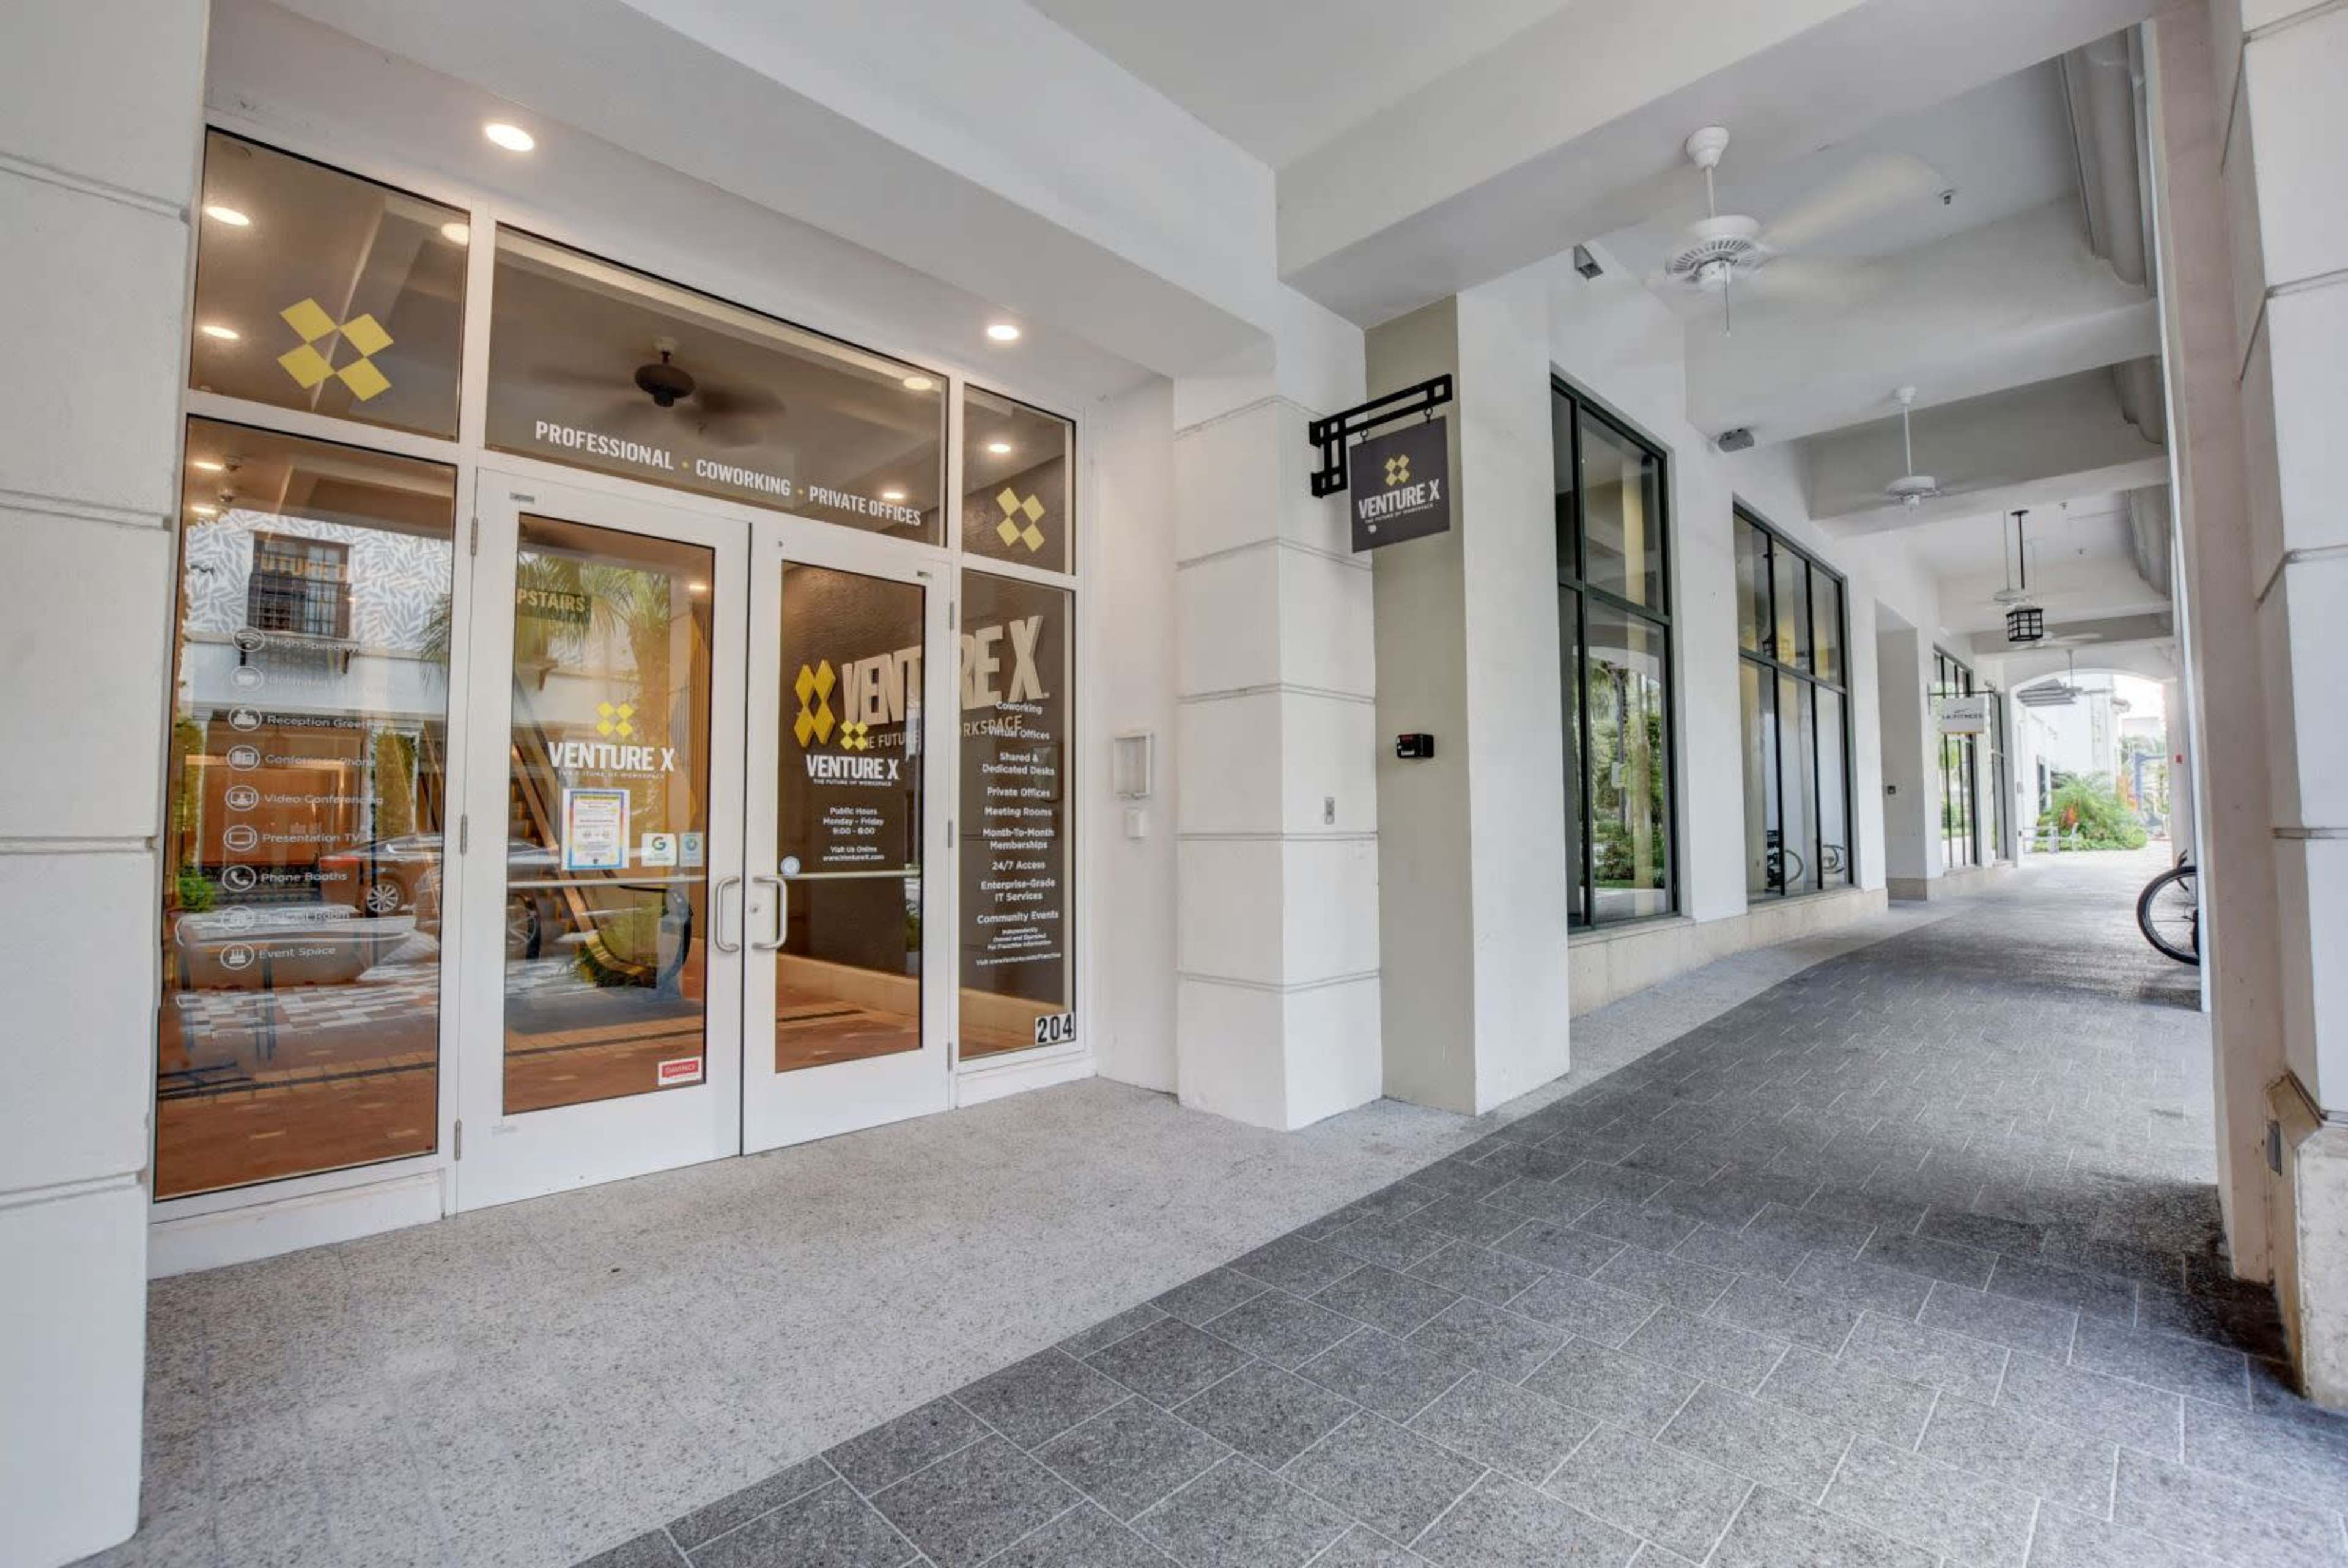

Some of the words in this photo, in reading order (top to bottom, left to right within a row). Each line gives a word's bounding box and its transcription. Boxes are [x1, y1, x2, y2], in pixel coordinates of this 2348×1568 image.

[536, 421, 674, 471] PROFESSIONAL
[696, 459, 791, 496] COWORKING
[1359, 484, 1425, 519] VENTURE
[1428, 479, 1440, 501] X
[809, 486, 866, 514] PRIVATE
[869, 499, 921, 527] OFFICES
[517, 588, 585, 612] PSTAIRS
[1009, 614, 1044, 702] X
[995, 701, 1043, 715] Coworking
[267, 715, 330, 728] Reception
[988, 726, 1017, 738] Virtual
[1019, 729, 1050, 740] Offices
[548, 741, 655, 771] VENTURE
[660, 748, 676, 773] X
[999, 751, 1030, 762] Shared
[805, 754, 884, 779] VENTURE
[887, 759, 899, 780] X
[982, 763, 1028, 775] Dedicated
[1030, 765, 1055, 776] Desks
[264, 793, 301, 804] Video
[986, 786, 1019, 797] Private
[1020, 787, 1050, 798] Offices
[830, 806, 854, 815] Public
[984, 806, 1021, 817] Meeting
[1023, 806, 1053, 817] Rooms
[822, 817, 855, 826] Monday
[860, 817, 884, 826] Friday
[262, 833, 340, 844] Presentation
[344, 834, 361, 843] TV
[982, 828, 1055, 837] Month-To-Month
[989, 840, 1048, 852] Memberships
[991, 860, 1014, 872] 24/7
[1016, 860, 1047, 870] Access
[260, 872, 302, 883] Phone
[305, 872, 349, 882] Booths
[980, 878, 1056, 891] Enterprise-Grade
[994, 893, 1005, 902] IT
[1006, 891, 1044, 902] Services
[976, 911, 1030, 924] Community
[1031, 910, 1059, 921] Events
[259, 948, 295, 959] Event
[298, 946, 336, 958] Space
[1037, 1014, 1072, 1043] 204
